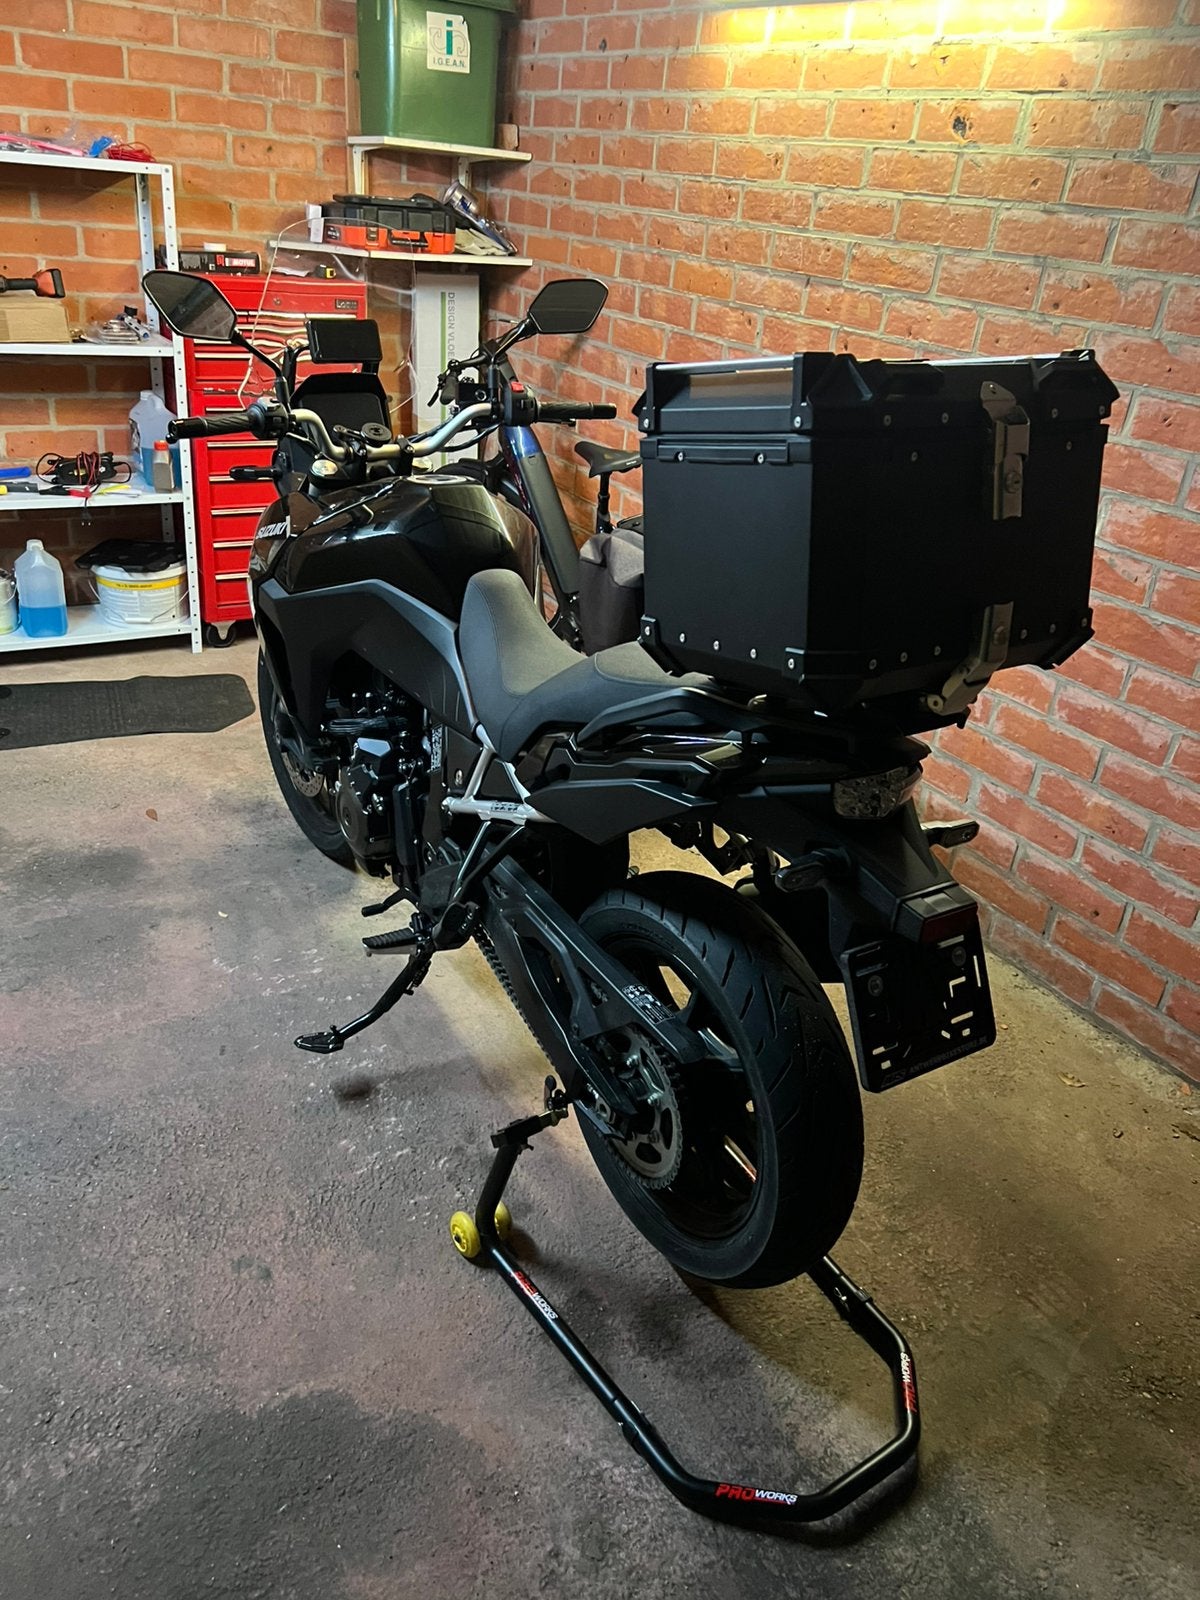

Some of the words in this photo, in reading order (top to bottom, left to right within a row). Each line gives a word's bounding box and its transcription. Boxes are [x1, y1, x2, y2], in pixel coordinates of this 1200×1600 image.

[447, 292, 456, 330] DESIGN
[447, 332, 456, 361] VLOE
[715, 1483, 798, 1505] PROWORKS
